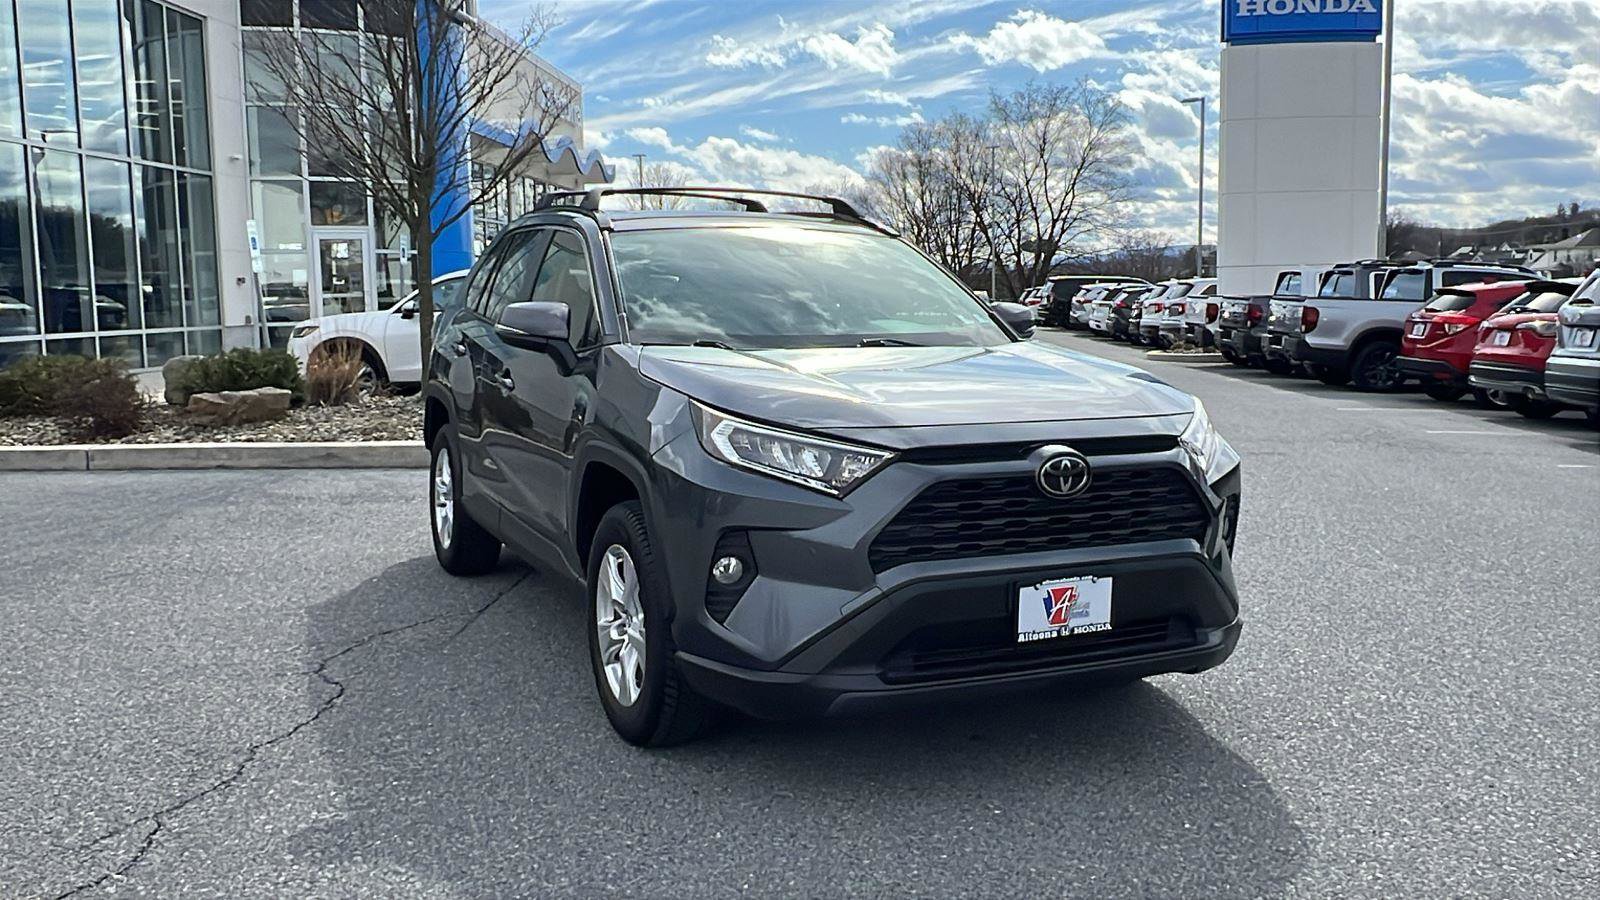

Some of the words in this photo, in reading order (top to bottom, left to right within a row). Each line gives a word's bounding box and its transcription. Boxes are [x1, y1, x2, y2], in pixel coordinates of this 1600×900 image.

[1236, 0, 1377, 16] HONDA
[1018, 630, 1057, 642] Altoona
[1073, 622, 1112, 634] HONDA
